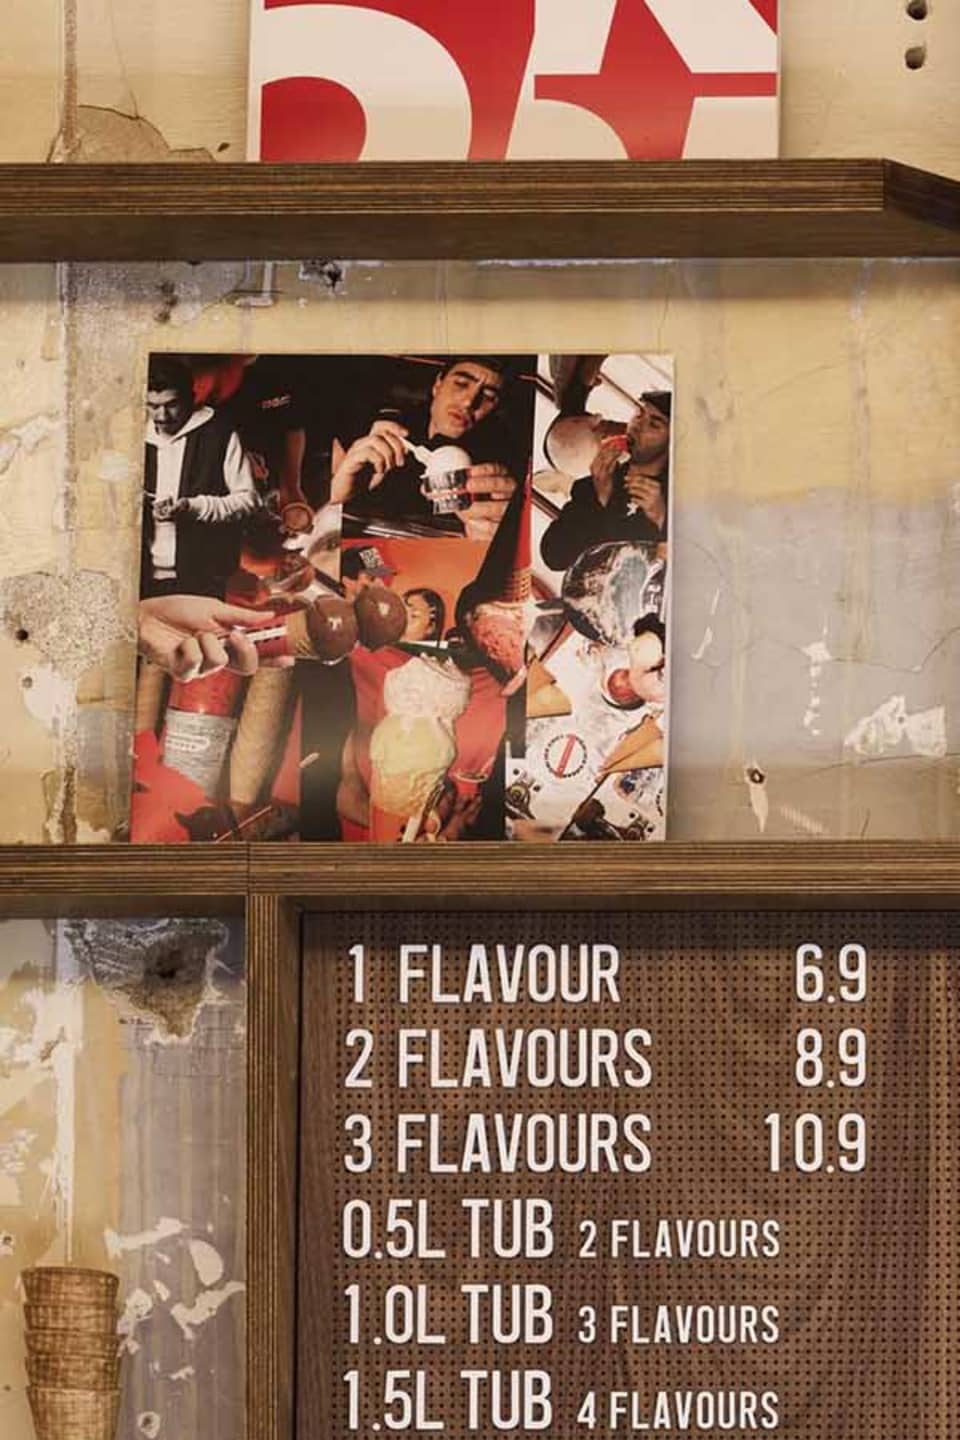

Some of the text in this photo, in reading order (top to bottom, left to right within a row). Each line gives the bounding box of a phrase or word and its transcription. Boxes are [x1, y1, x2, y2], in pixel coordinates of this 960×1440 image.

[349, 943, 867, 1004] 1 FLAVOUR 6.9
[345, 1028, 866, 1089] 2 FLAVOURS 8.9
[344, 1113, 866, 1174] 3 FLAVOURS 10.9
[343, 1198, 446, 1260] 0.5L
[461, 1198, 554, 1258] TUB
[579, 1220, 597, 1258] 2
[611, 1220, 780, 1258] FLAVOURS
[344, 1284, 446, 1345] 1.0L
[460, 1284, 553, 1344] TUB
[578, 1305, 596, 1344] 3
[611, 1305, 779, 1344] FLAVOURS
[343, 1370, 445, 1431] 1.5L
[460, 1369, 553, 1430] TUB
[577, 1391, 596, 1429] 4
[610, 1391, 779, 1430] FLAVOURS
